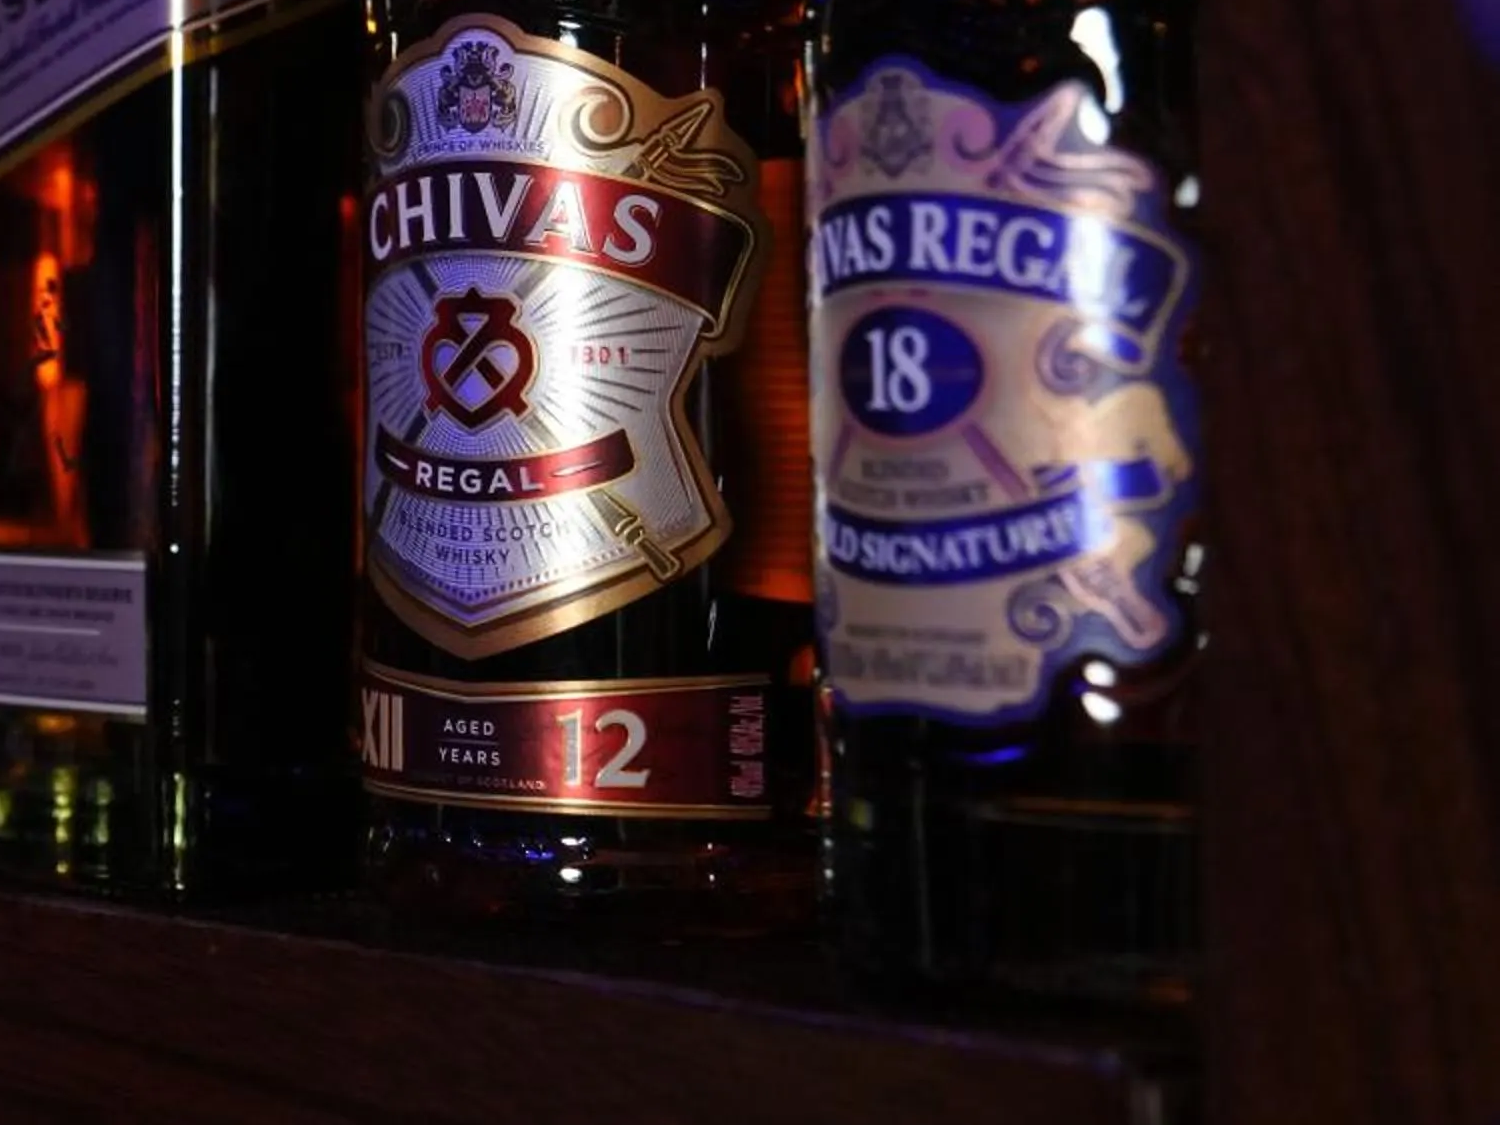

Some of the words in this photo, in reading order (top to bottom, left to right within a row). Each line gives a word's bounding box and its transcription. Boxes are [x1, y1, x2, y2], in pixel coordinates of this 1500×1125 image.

[369, 172, 660, 266] CHIVAS
[864, 326, 931, 412] 18
[415, 460, 544, 494] REGAL
[434, 543, 511, 565] WHISKY
[361, 687, 405, 772] XII
[443, 718, 496, 737] AGED
[555, 707, 652, 788] 12
[438, 747, 501, 767] YEARS
